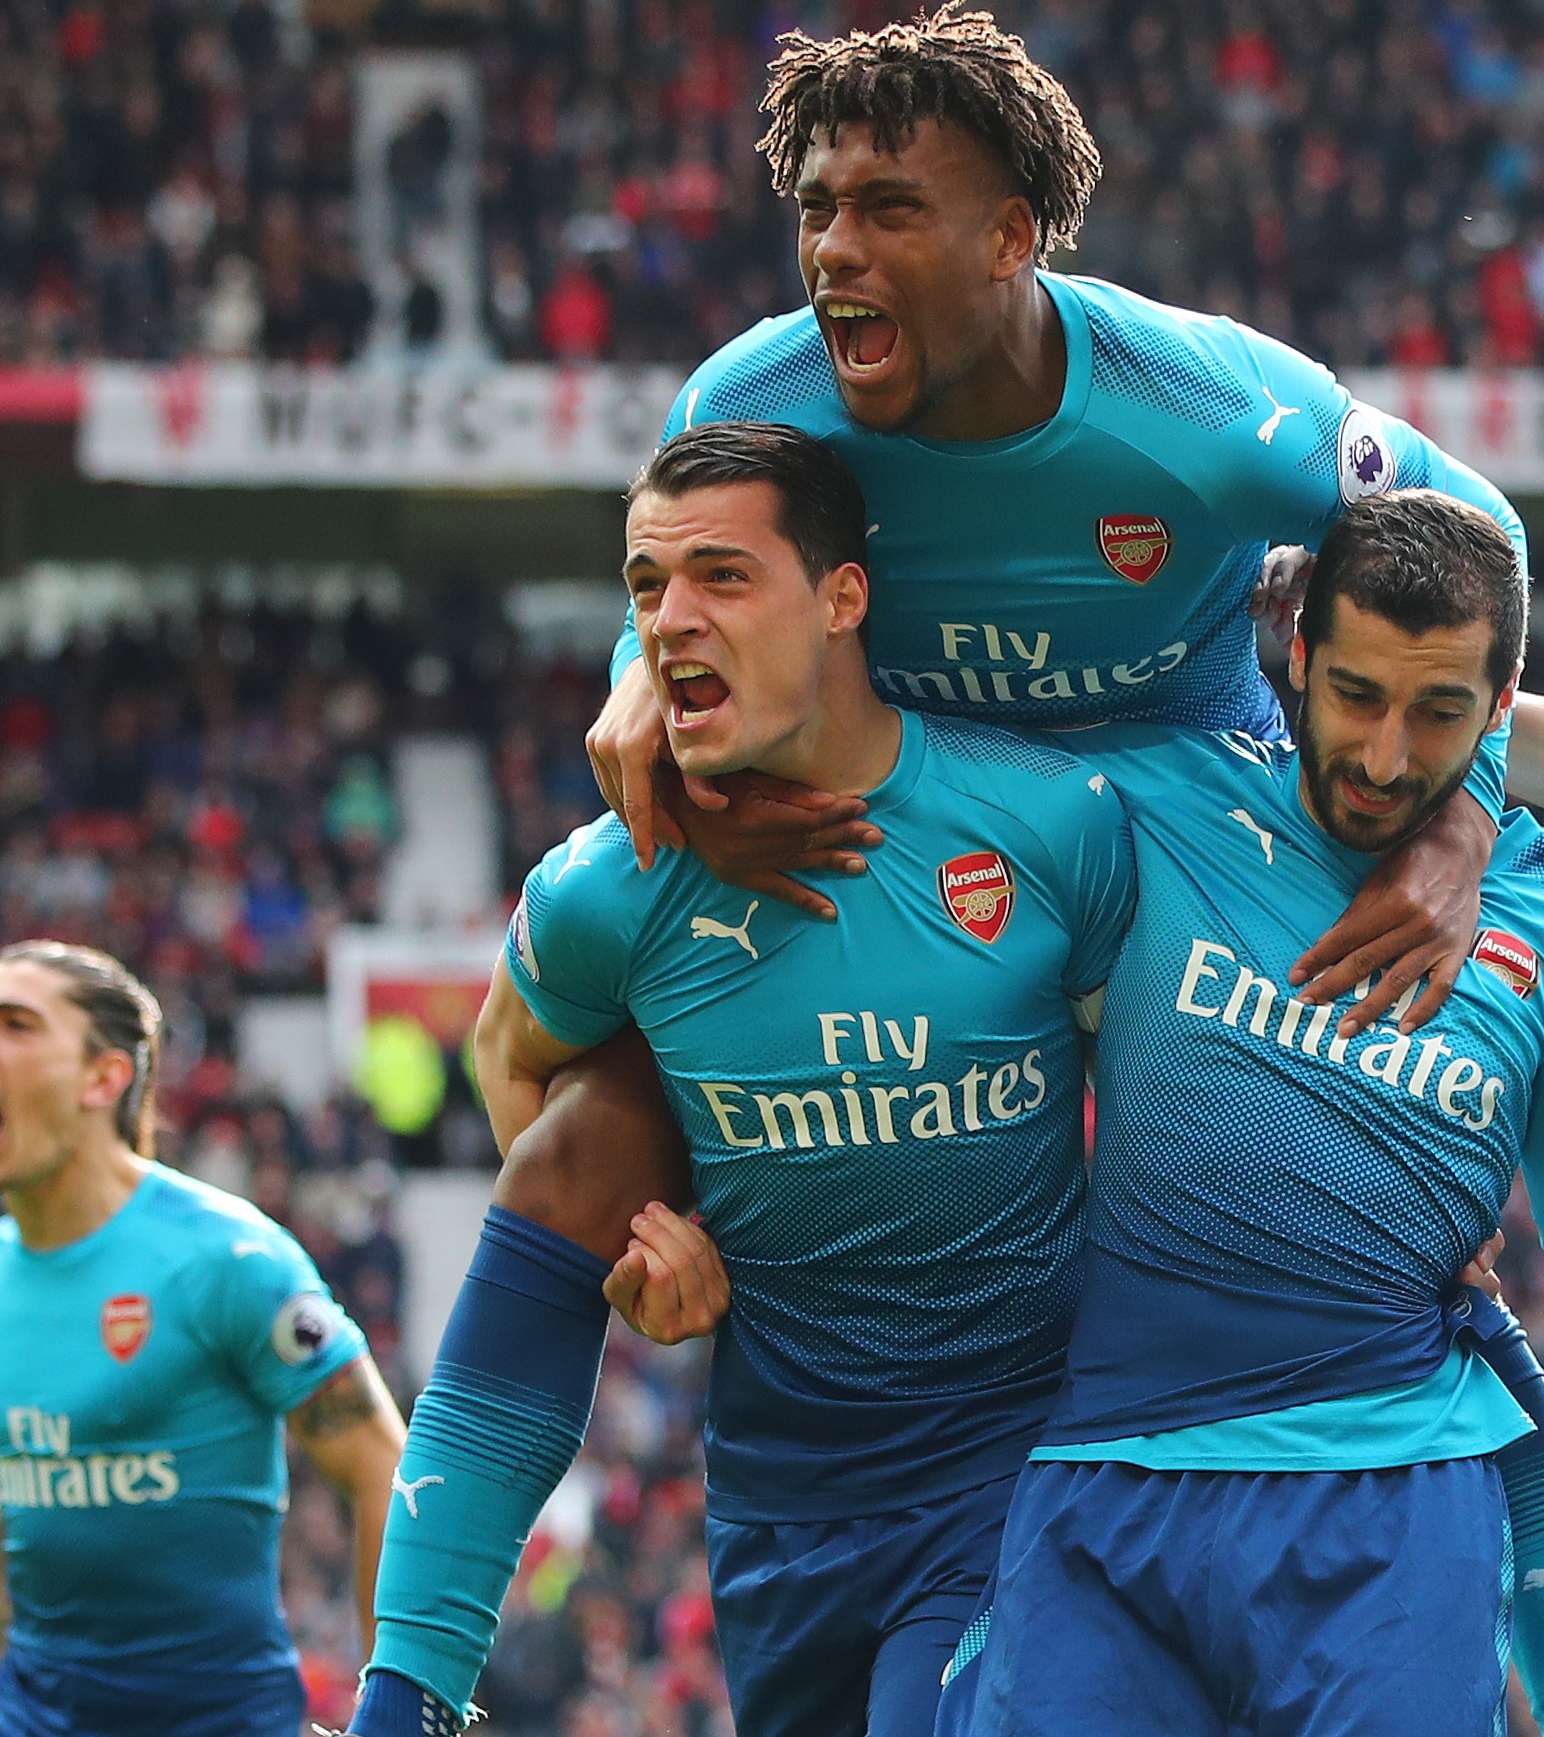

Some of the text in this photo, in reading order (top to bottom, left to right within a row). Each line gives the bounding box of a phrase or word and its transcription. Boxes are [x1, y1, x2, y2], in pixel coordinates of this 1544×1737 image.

[1103, 521, 1162, 537] Arsenal
[938, 622, 1051, 670] Fly
[946, 862, 1001, 888] Arsenal
[1480, 937, 1534, 971] Arsenal
[817, 1011, 929, 1070] Fly
[699, 1048, 1046, 1149] Emirates
[6, 1405, 70, 1456] Fly
